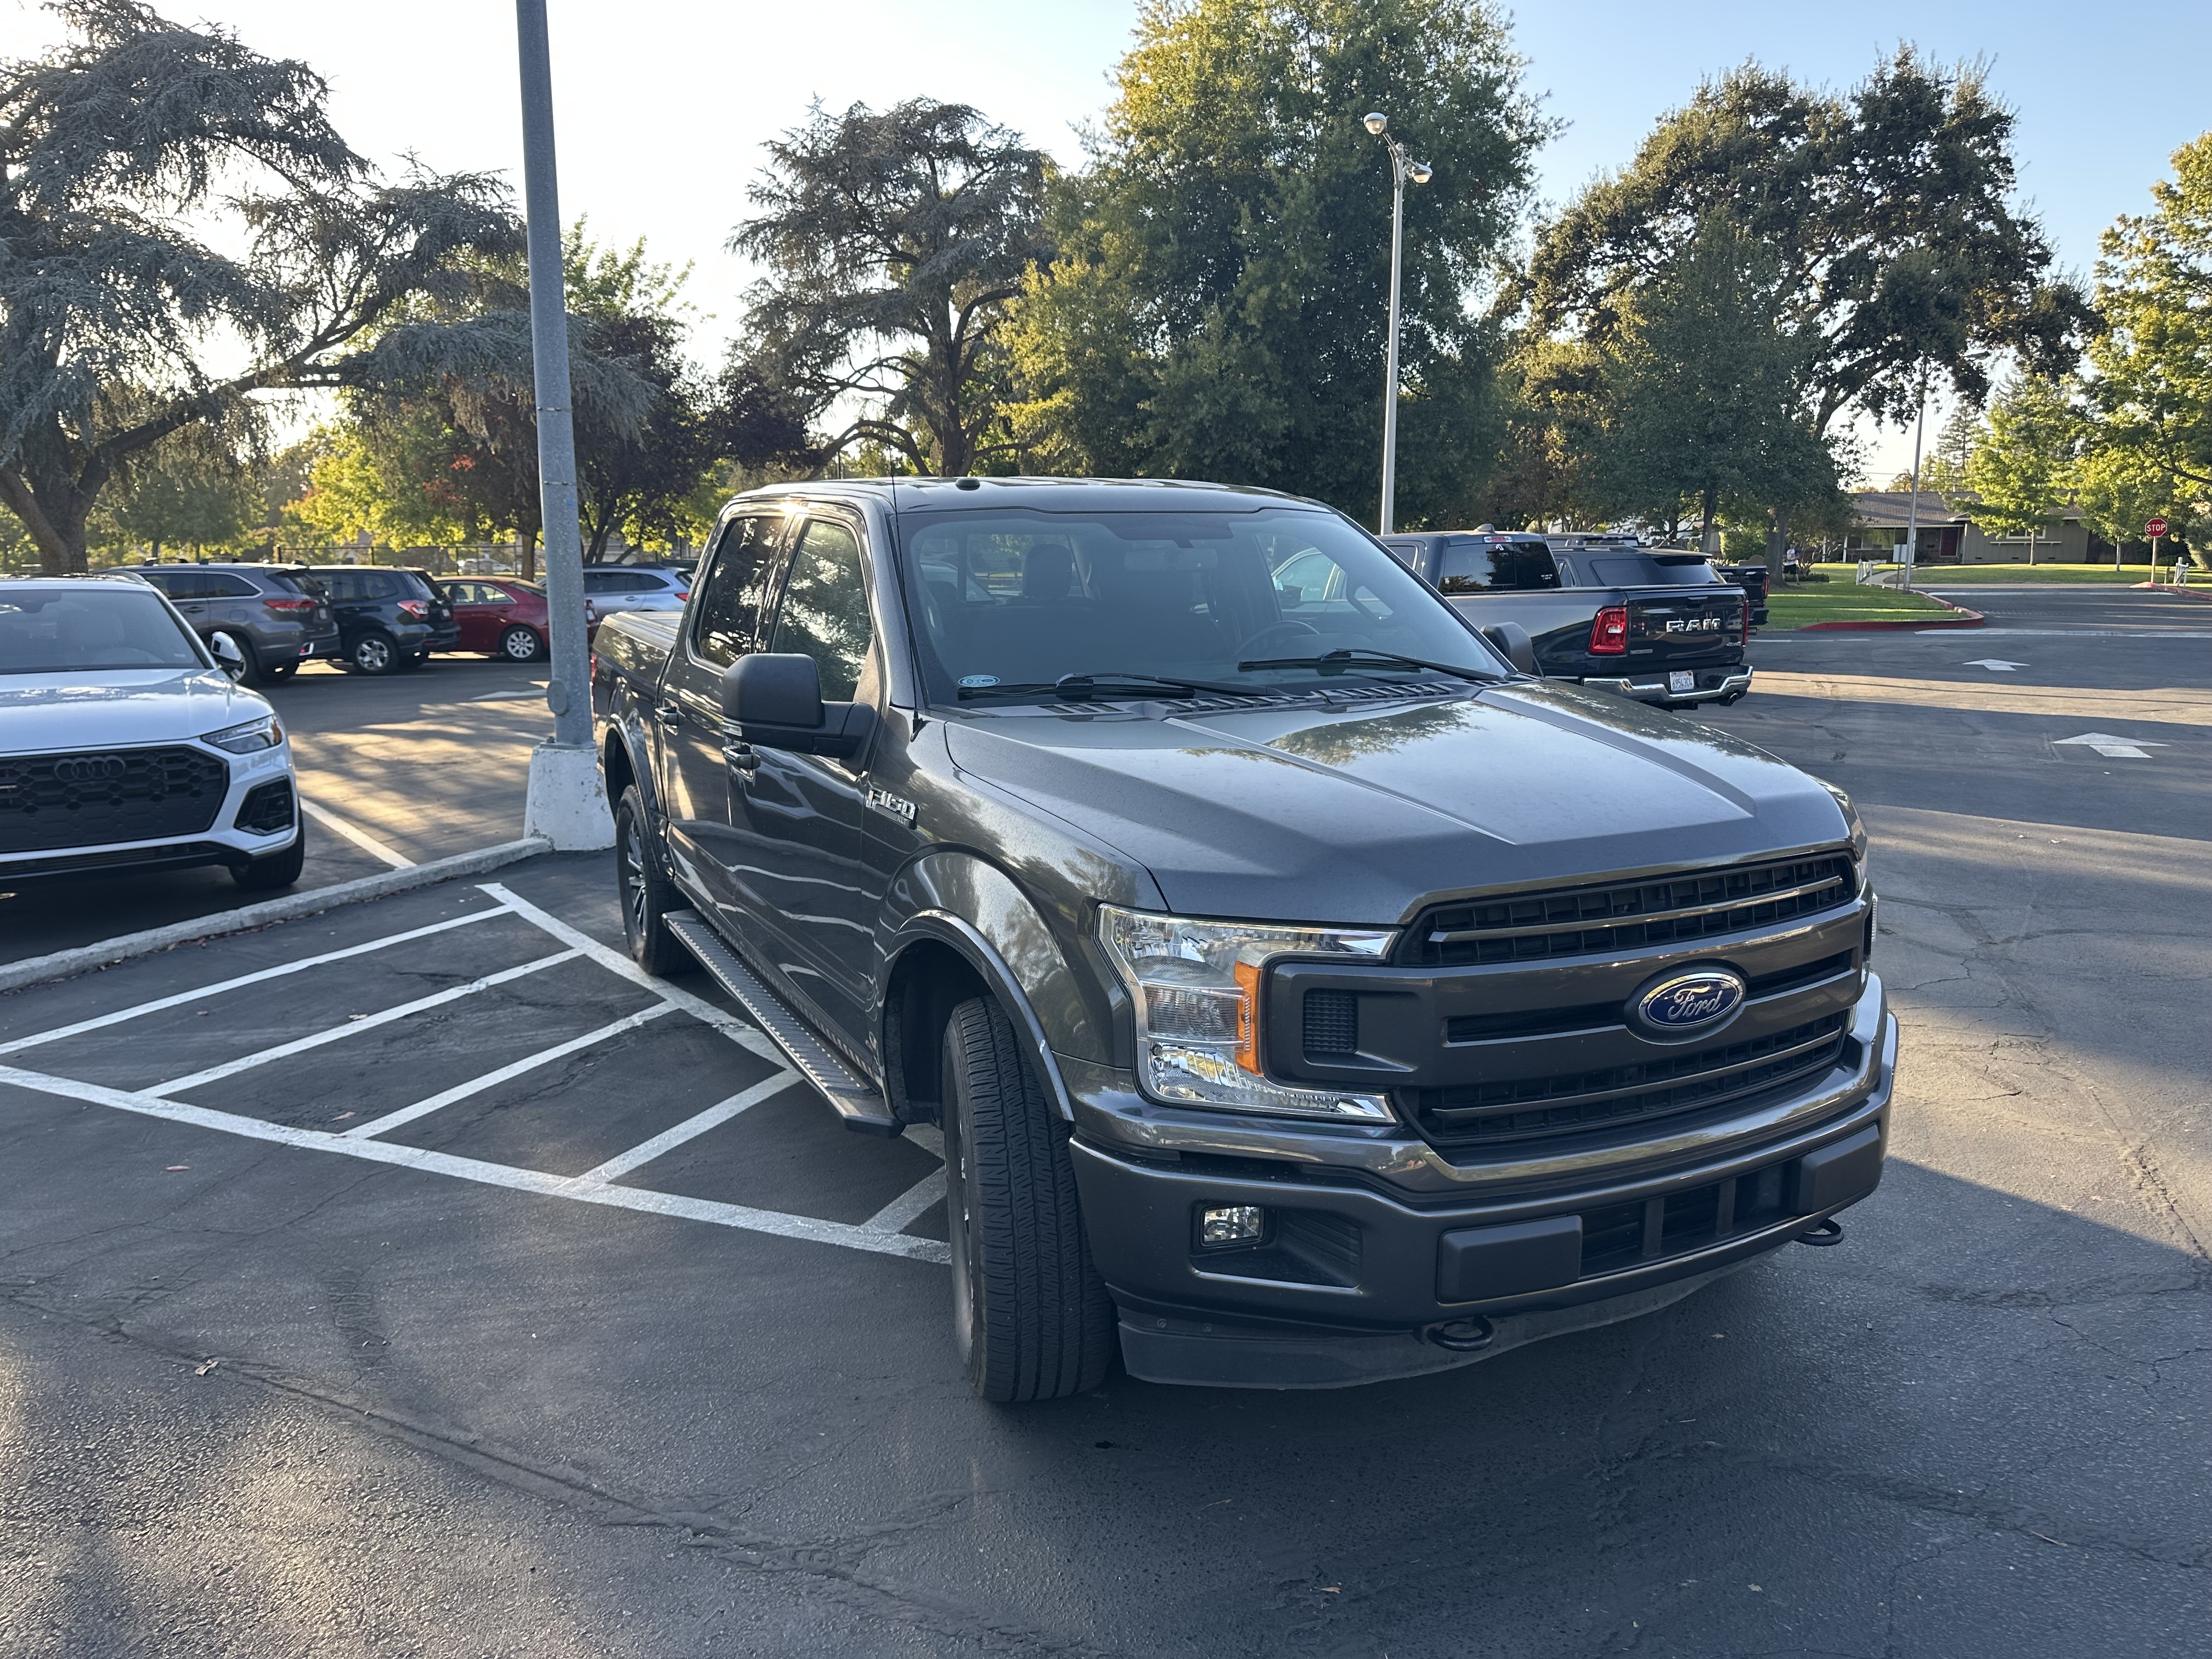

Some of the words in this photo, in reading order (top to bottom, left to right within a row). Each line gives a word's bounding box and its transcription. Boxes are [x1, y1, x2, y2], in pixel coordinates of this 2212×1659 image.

[2146, 524, 2166, 532] STOP
[1666, 618, 1720, 633] RAM
[896, 815, 908, 825] XLT
[1667, 986, 1723, 1020] Ford
